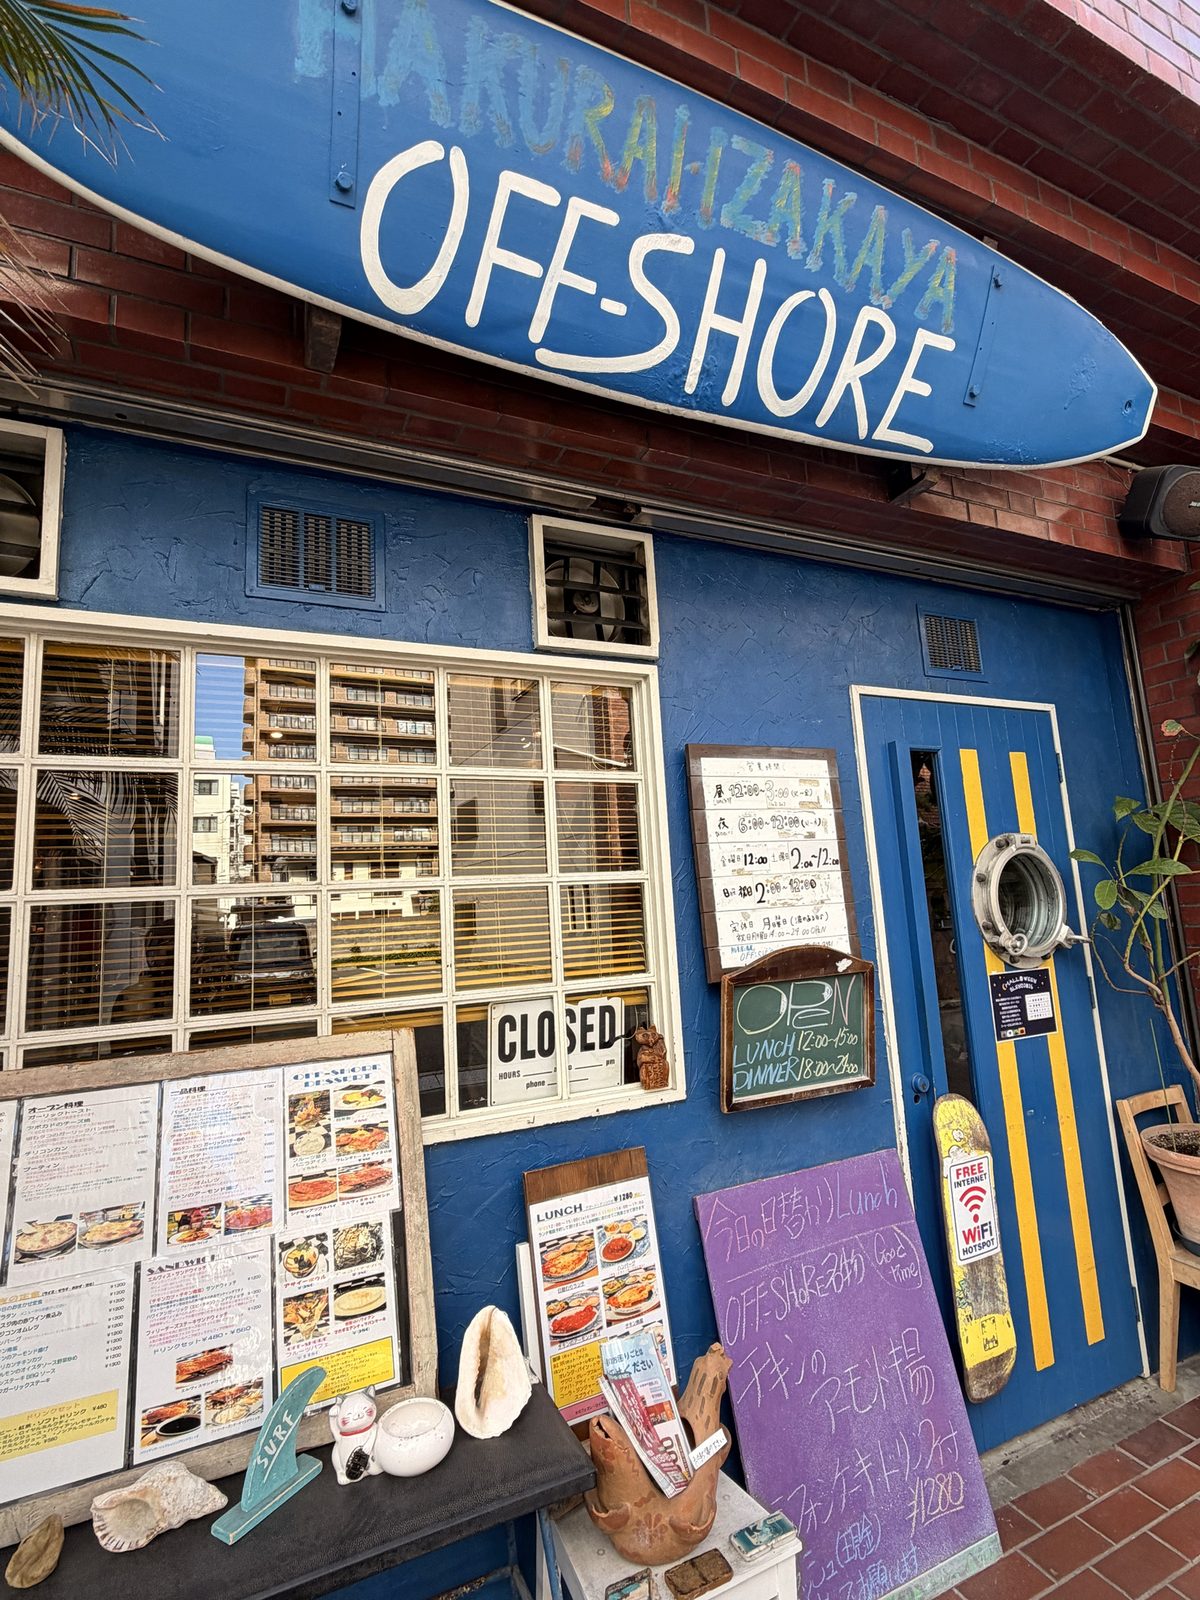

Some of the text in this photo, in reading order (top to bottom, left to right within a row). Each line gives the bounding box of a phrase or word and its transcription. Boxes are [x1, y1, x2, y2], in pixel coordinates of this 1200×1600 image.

[360, 138, 956, 453] OFF-SHORE
[717, 817, 729, 830] 夜
[736, 975, 857, 1035] OPEN
[497, 1004, 617, 1063] CLOSED
[733, 1031, 796, 1068] LUNCH
[498, 1070, 521, 1081] HOURS
[525, 1080, 546, 1090] phone
[733, 1056, 801, 1093] DINNER
[953, 1173, 988, 1189] INTERNET
[955, 1162, 985, 1181] FREE
[536, 1203, 583, 1223] LUNCH
[962, 1221, 993, 1246] WiFi
[962, 1238, 996, 1256] HOTSPOT
[257, 1410, 296, 1469] SURF
